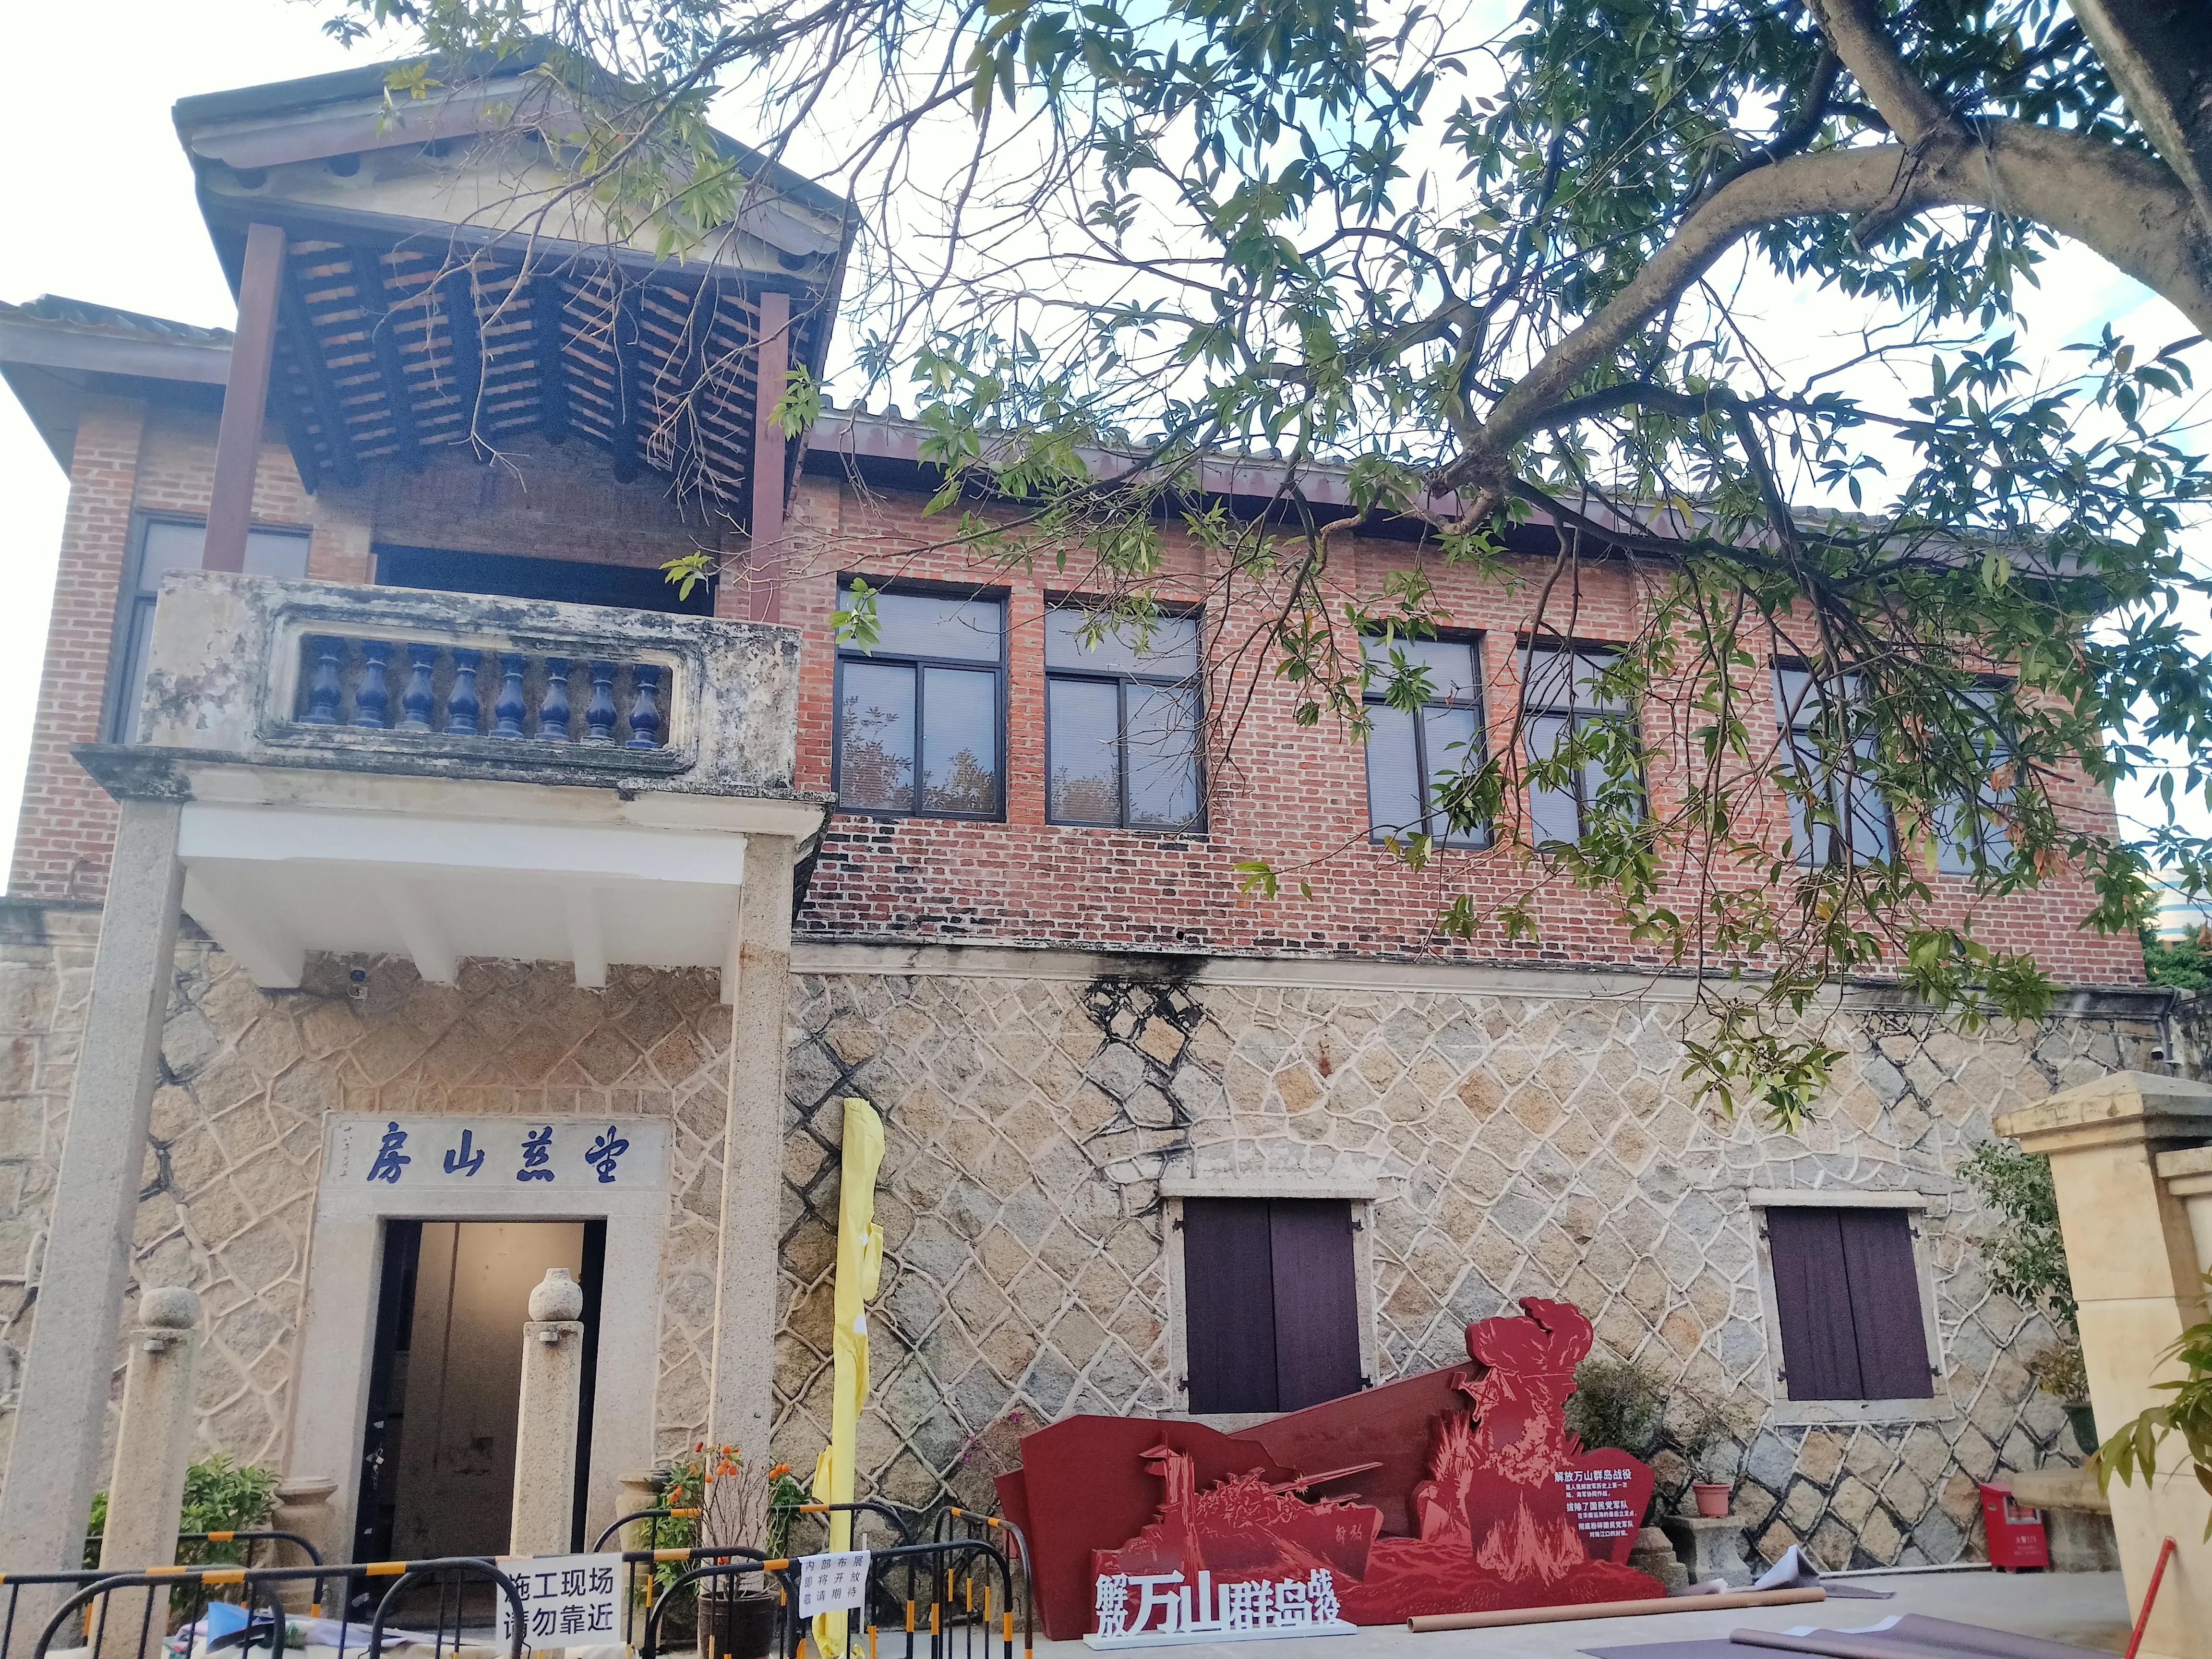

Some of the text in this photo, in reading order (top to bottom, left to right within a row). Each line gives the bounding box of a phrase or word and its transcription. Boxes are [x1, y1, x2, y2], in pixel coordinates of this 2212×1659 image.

[1554, 1468, 1632, 1482] 解放万山群岛战役
[1566, 1500, 1629, 1512] 拔除了国民党军队
[1578, 1520, 1634, 1530] 彻底粉碎国民党军队
[805, 1556, 863, 1572] 内部布展
[805, 1571, 861, 1588] 即将开放
[804, 1586, 857, 1605] 敬请期待
